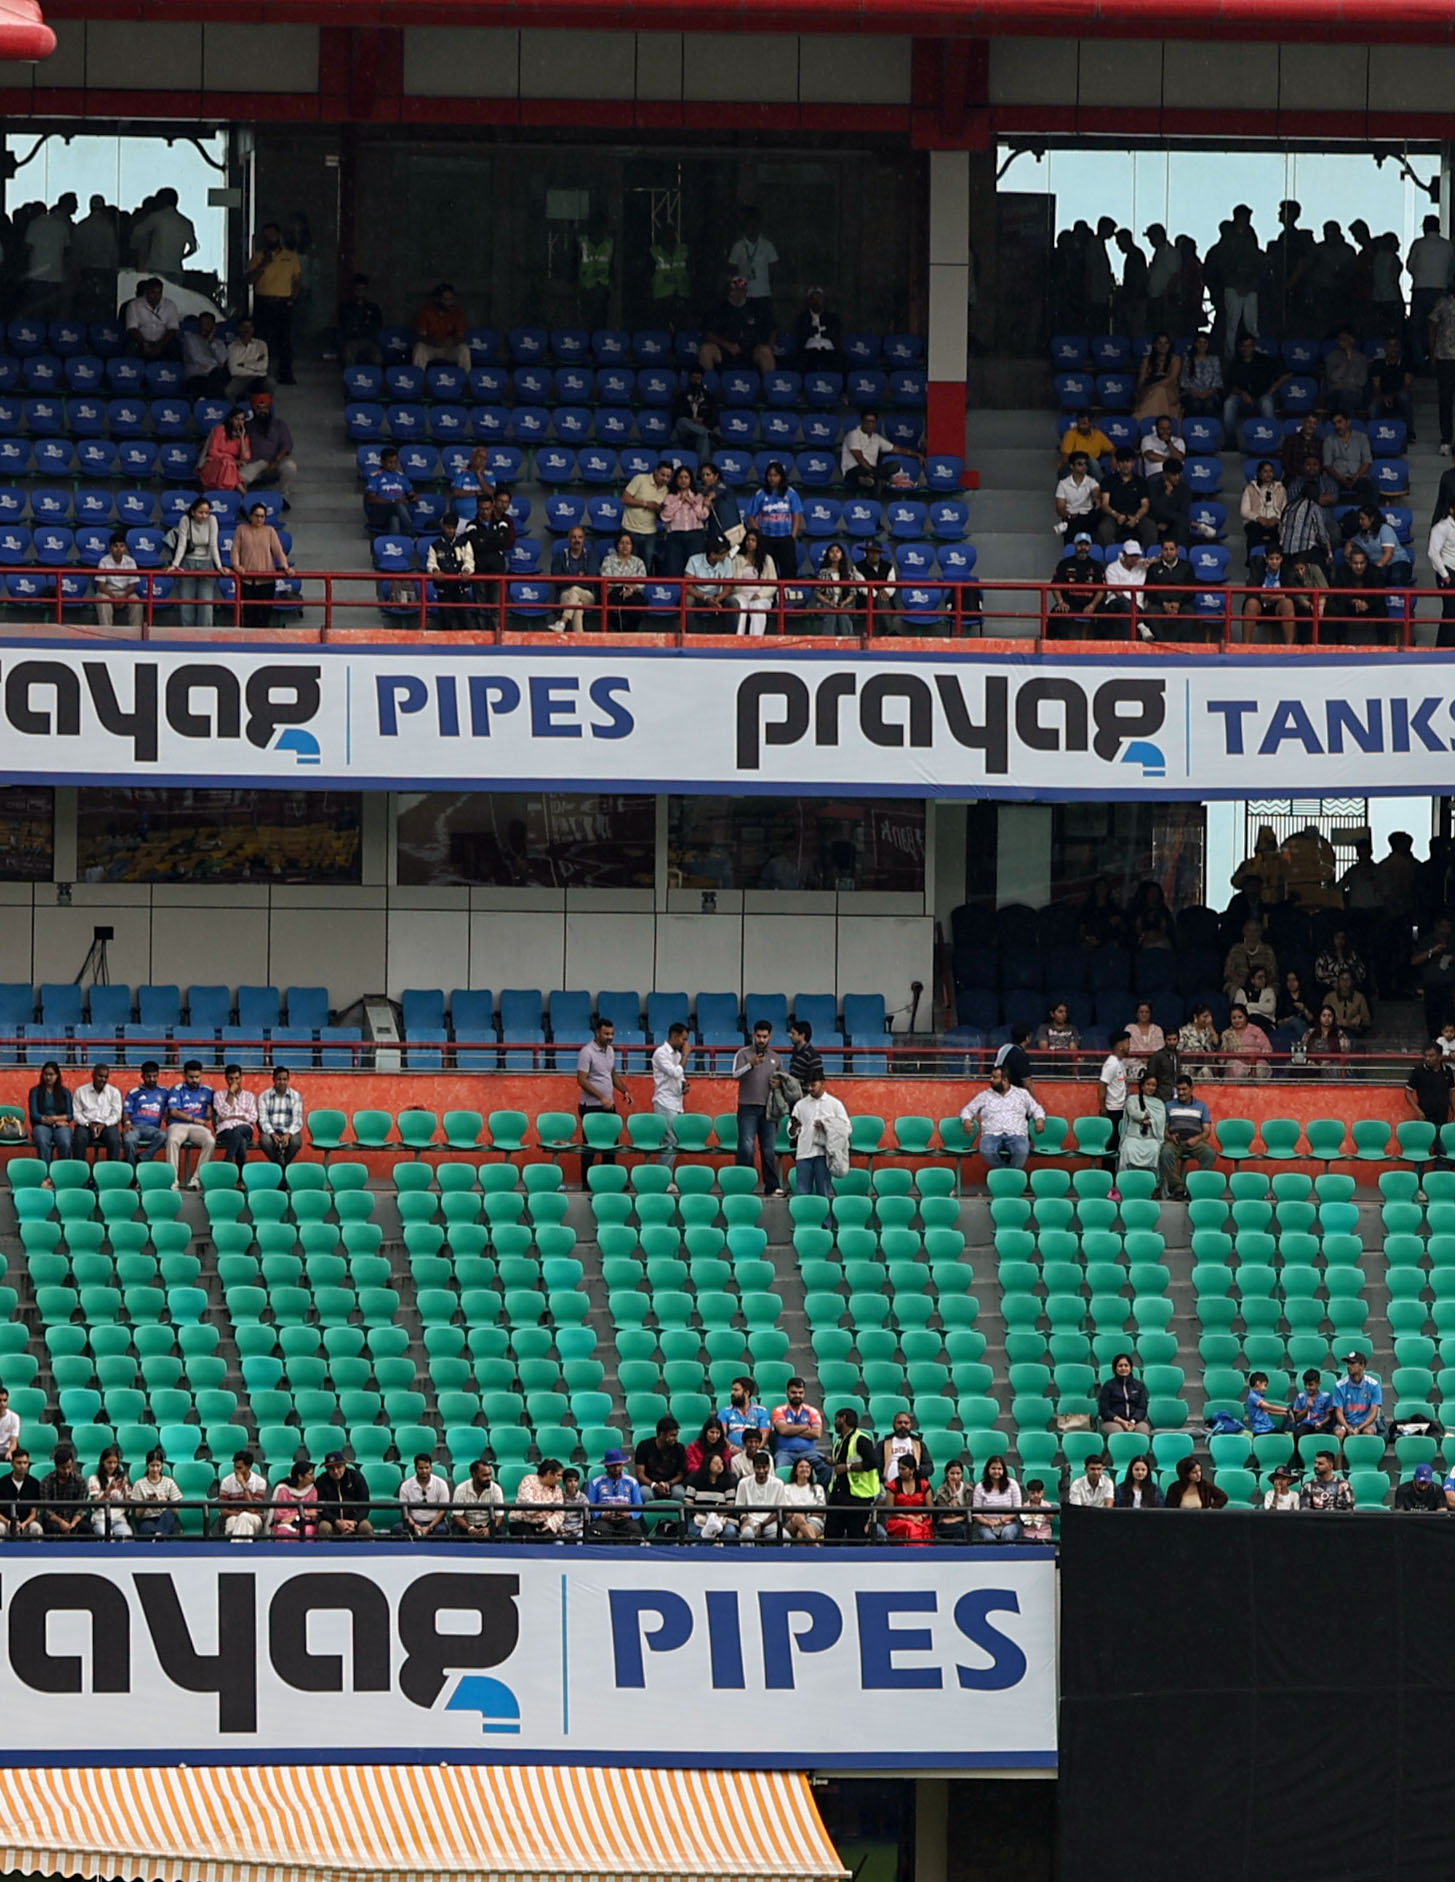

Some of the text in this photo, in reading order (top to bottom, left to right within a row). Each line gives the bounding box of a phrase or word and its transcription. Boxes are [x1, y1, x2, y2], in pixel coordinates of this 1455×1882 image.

[375, 675, 635, 740] PIPES
[737, 671, 1166, 777] prayag
[608, 1588, 1027, 1691] PIPES
